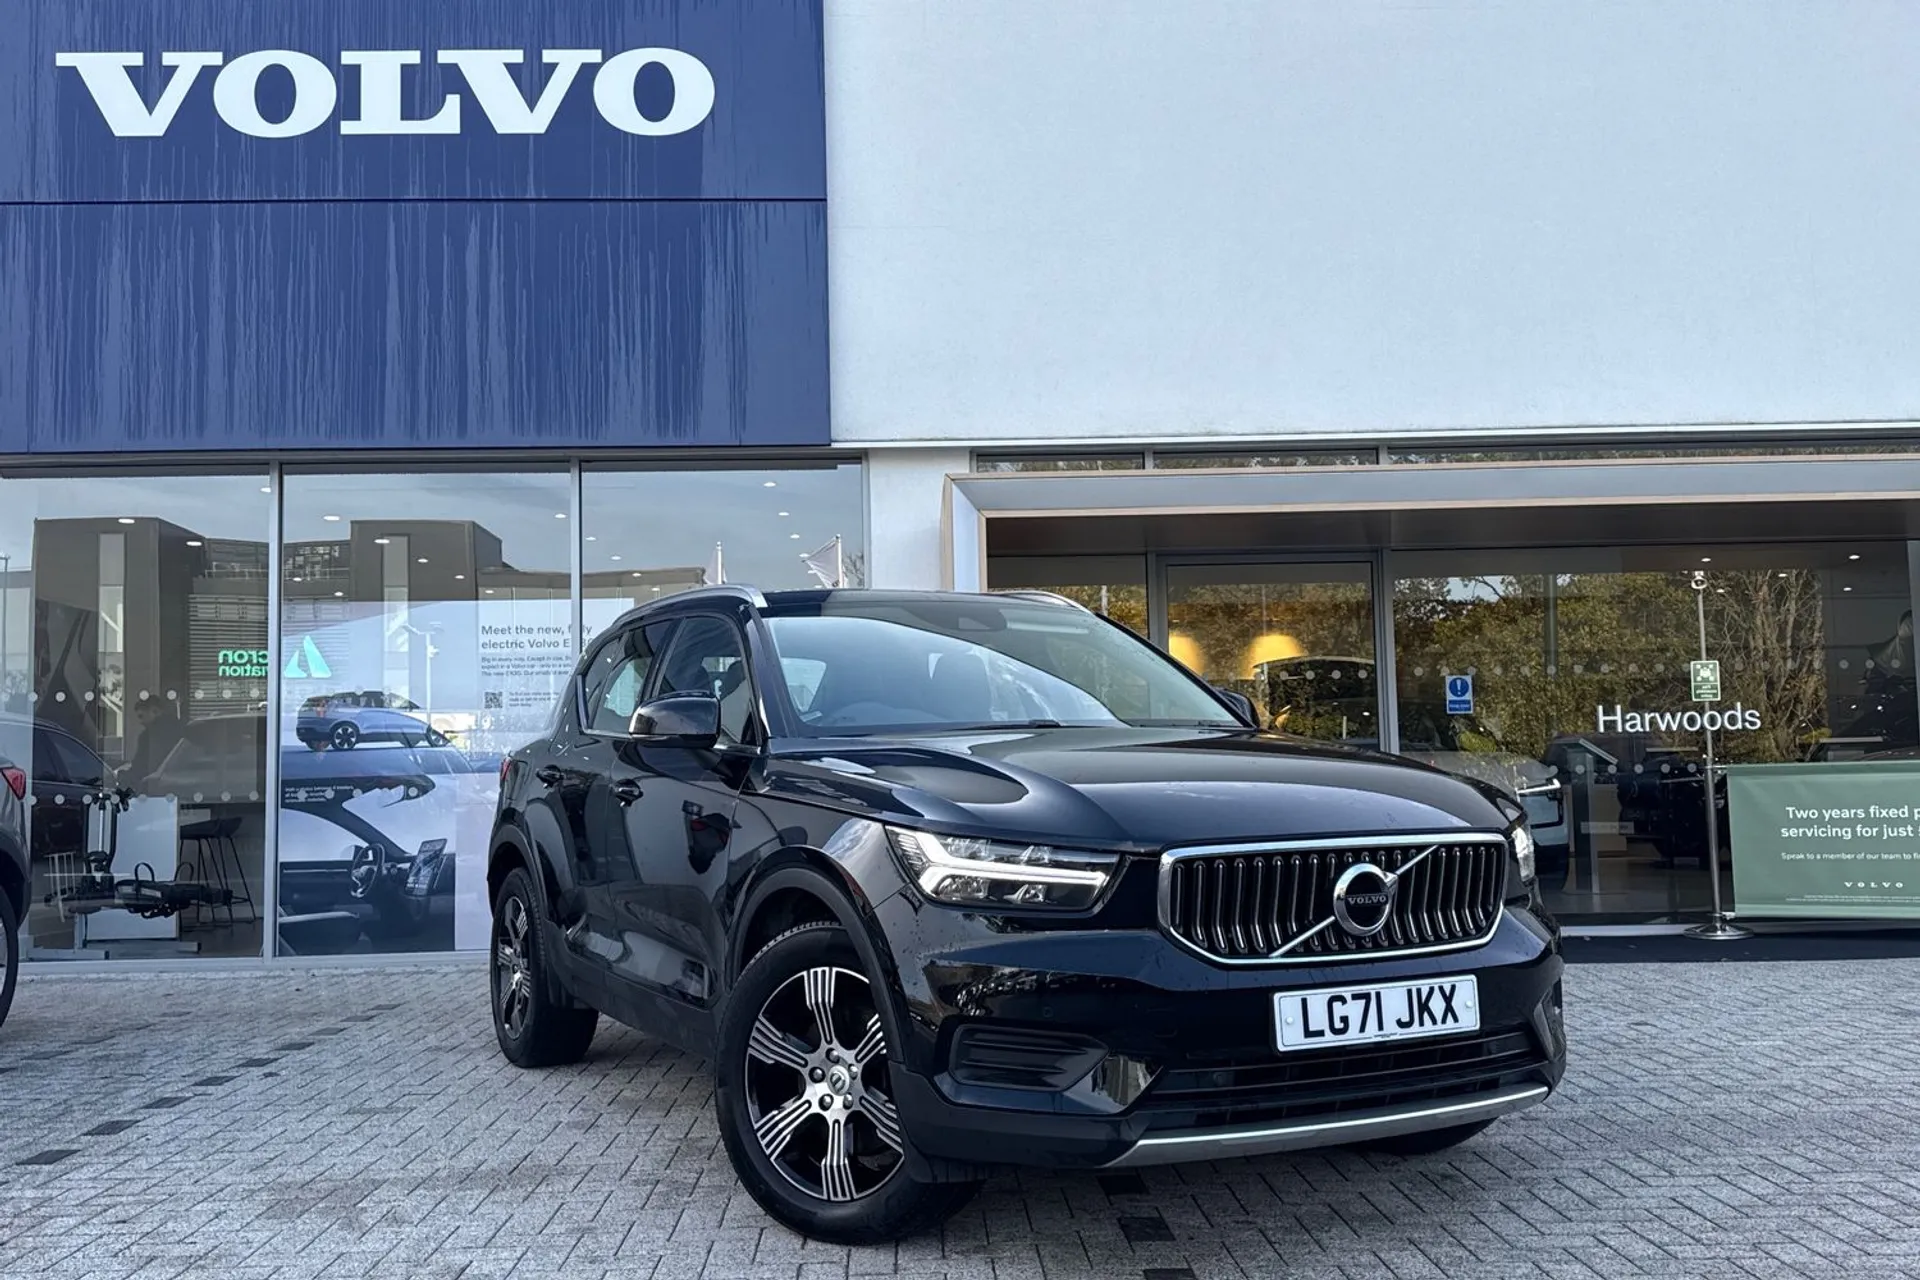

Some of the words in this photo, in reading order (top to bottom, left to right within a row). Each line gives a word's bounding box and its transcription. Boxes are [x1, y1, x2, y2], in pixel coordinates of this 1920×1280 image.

[55, 47, 715, 138] VOLVO
[481, 625, 511, 635] Meet
[515, 624, 534, 634] the
[537, 626, 565, 636] new,
[481, 639, 525, 649] electric
[528, 639, 559, 648] Volvo
[1597, 702, 1762, 733] Harwoods
[1786, 806, 1818, 819] Two
[1822, 807, 1865, 821] years
[1869, 805, 1908, 818] fixed
[1781, 824, 1851, 840] servicing
[1856, 824, 1879, 837] for
[1883, 824, 1914, 840] just
[1781, 852, 1805, 860] Speak
[1348, 895, 1386, 905] VOLVO
[1301, 991, 1384, 1039] LG71
[1396, 984, 1459, 1029] JKX
